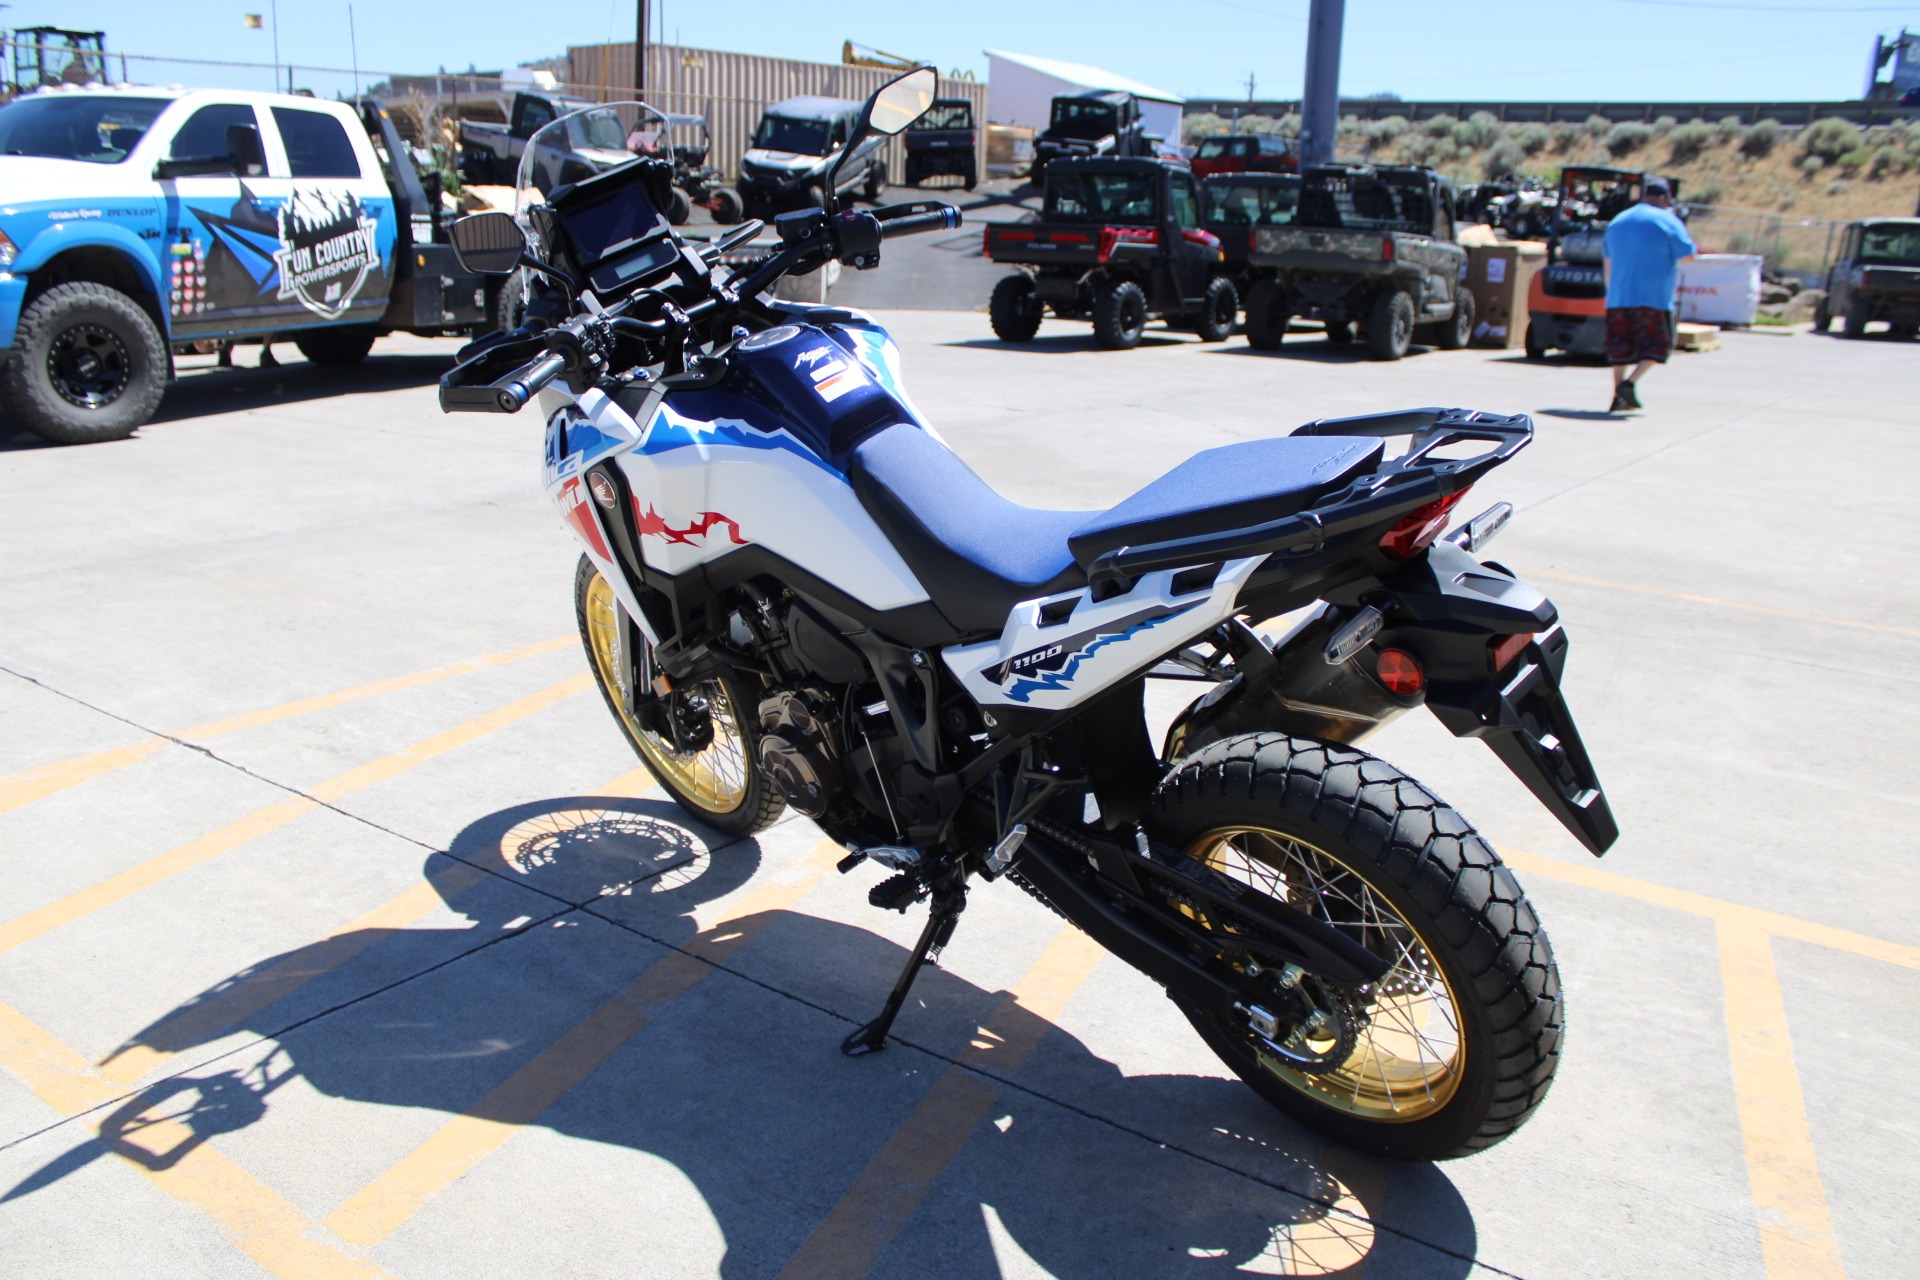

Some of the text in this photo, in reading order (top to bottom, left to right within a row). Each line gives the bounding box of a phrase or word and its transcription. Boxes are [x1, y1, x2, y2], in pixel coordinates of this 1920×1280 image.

[107, 208, 157, 217] DUNLOP
[281, 246, 313, 292] FUN
[315, 227, 372, 266] COUNTRY
[294, 252, 367, 287] POWERSPORTS
[1550, 270, 1602, 283] TOYOTA
[1014, 644, 1063, 669] 1100
